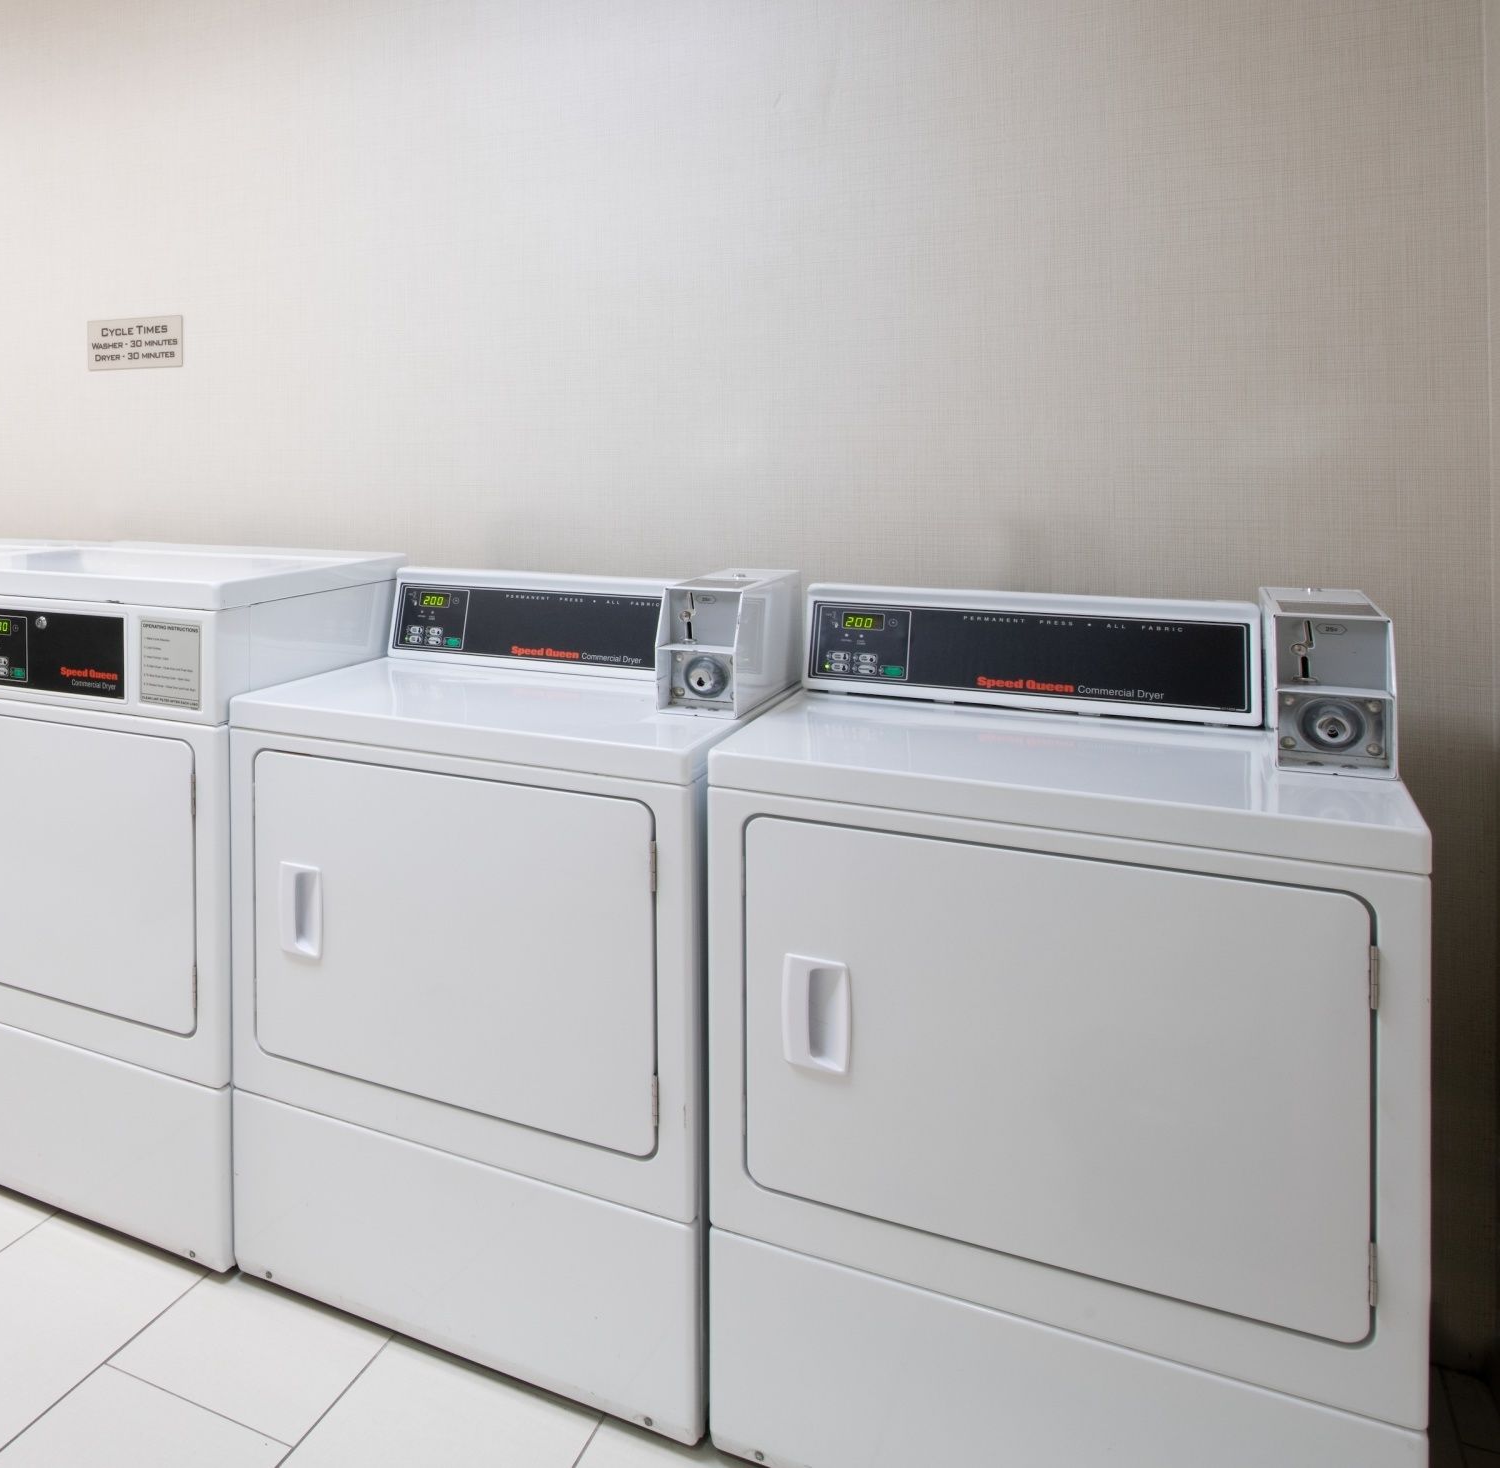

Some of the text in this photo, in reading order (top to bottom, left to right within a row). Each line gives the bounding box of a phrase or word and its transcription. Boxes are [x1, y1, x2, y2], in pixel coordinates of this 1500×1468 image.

[101, 325, 168, 337] CYCLE TIMES
[92, 342, 123, 350] WASHER
[130, 340, 142, 348] 30
[145, 339, 178, 347] MINUTES
[95, 353, 121, 362] DRYER
[127, 352, 140, 360] 30
[142, 351, 175, 359] MINUTES
[963, 615, 1026, 624] PERMANENT
[1039, 619, 1074, 627] PRESS
[1141, 625, 1184, 633] FABRIC
[511, 645, 642, 665] Speed Queen Commercial Dryer
[60, 666, 118, 680] Speed Queen
[71, 679, 116, 691] Commercial Dryer
[977, 676, 1164, 701] Speed Queen Commercial Dryer
